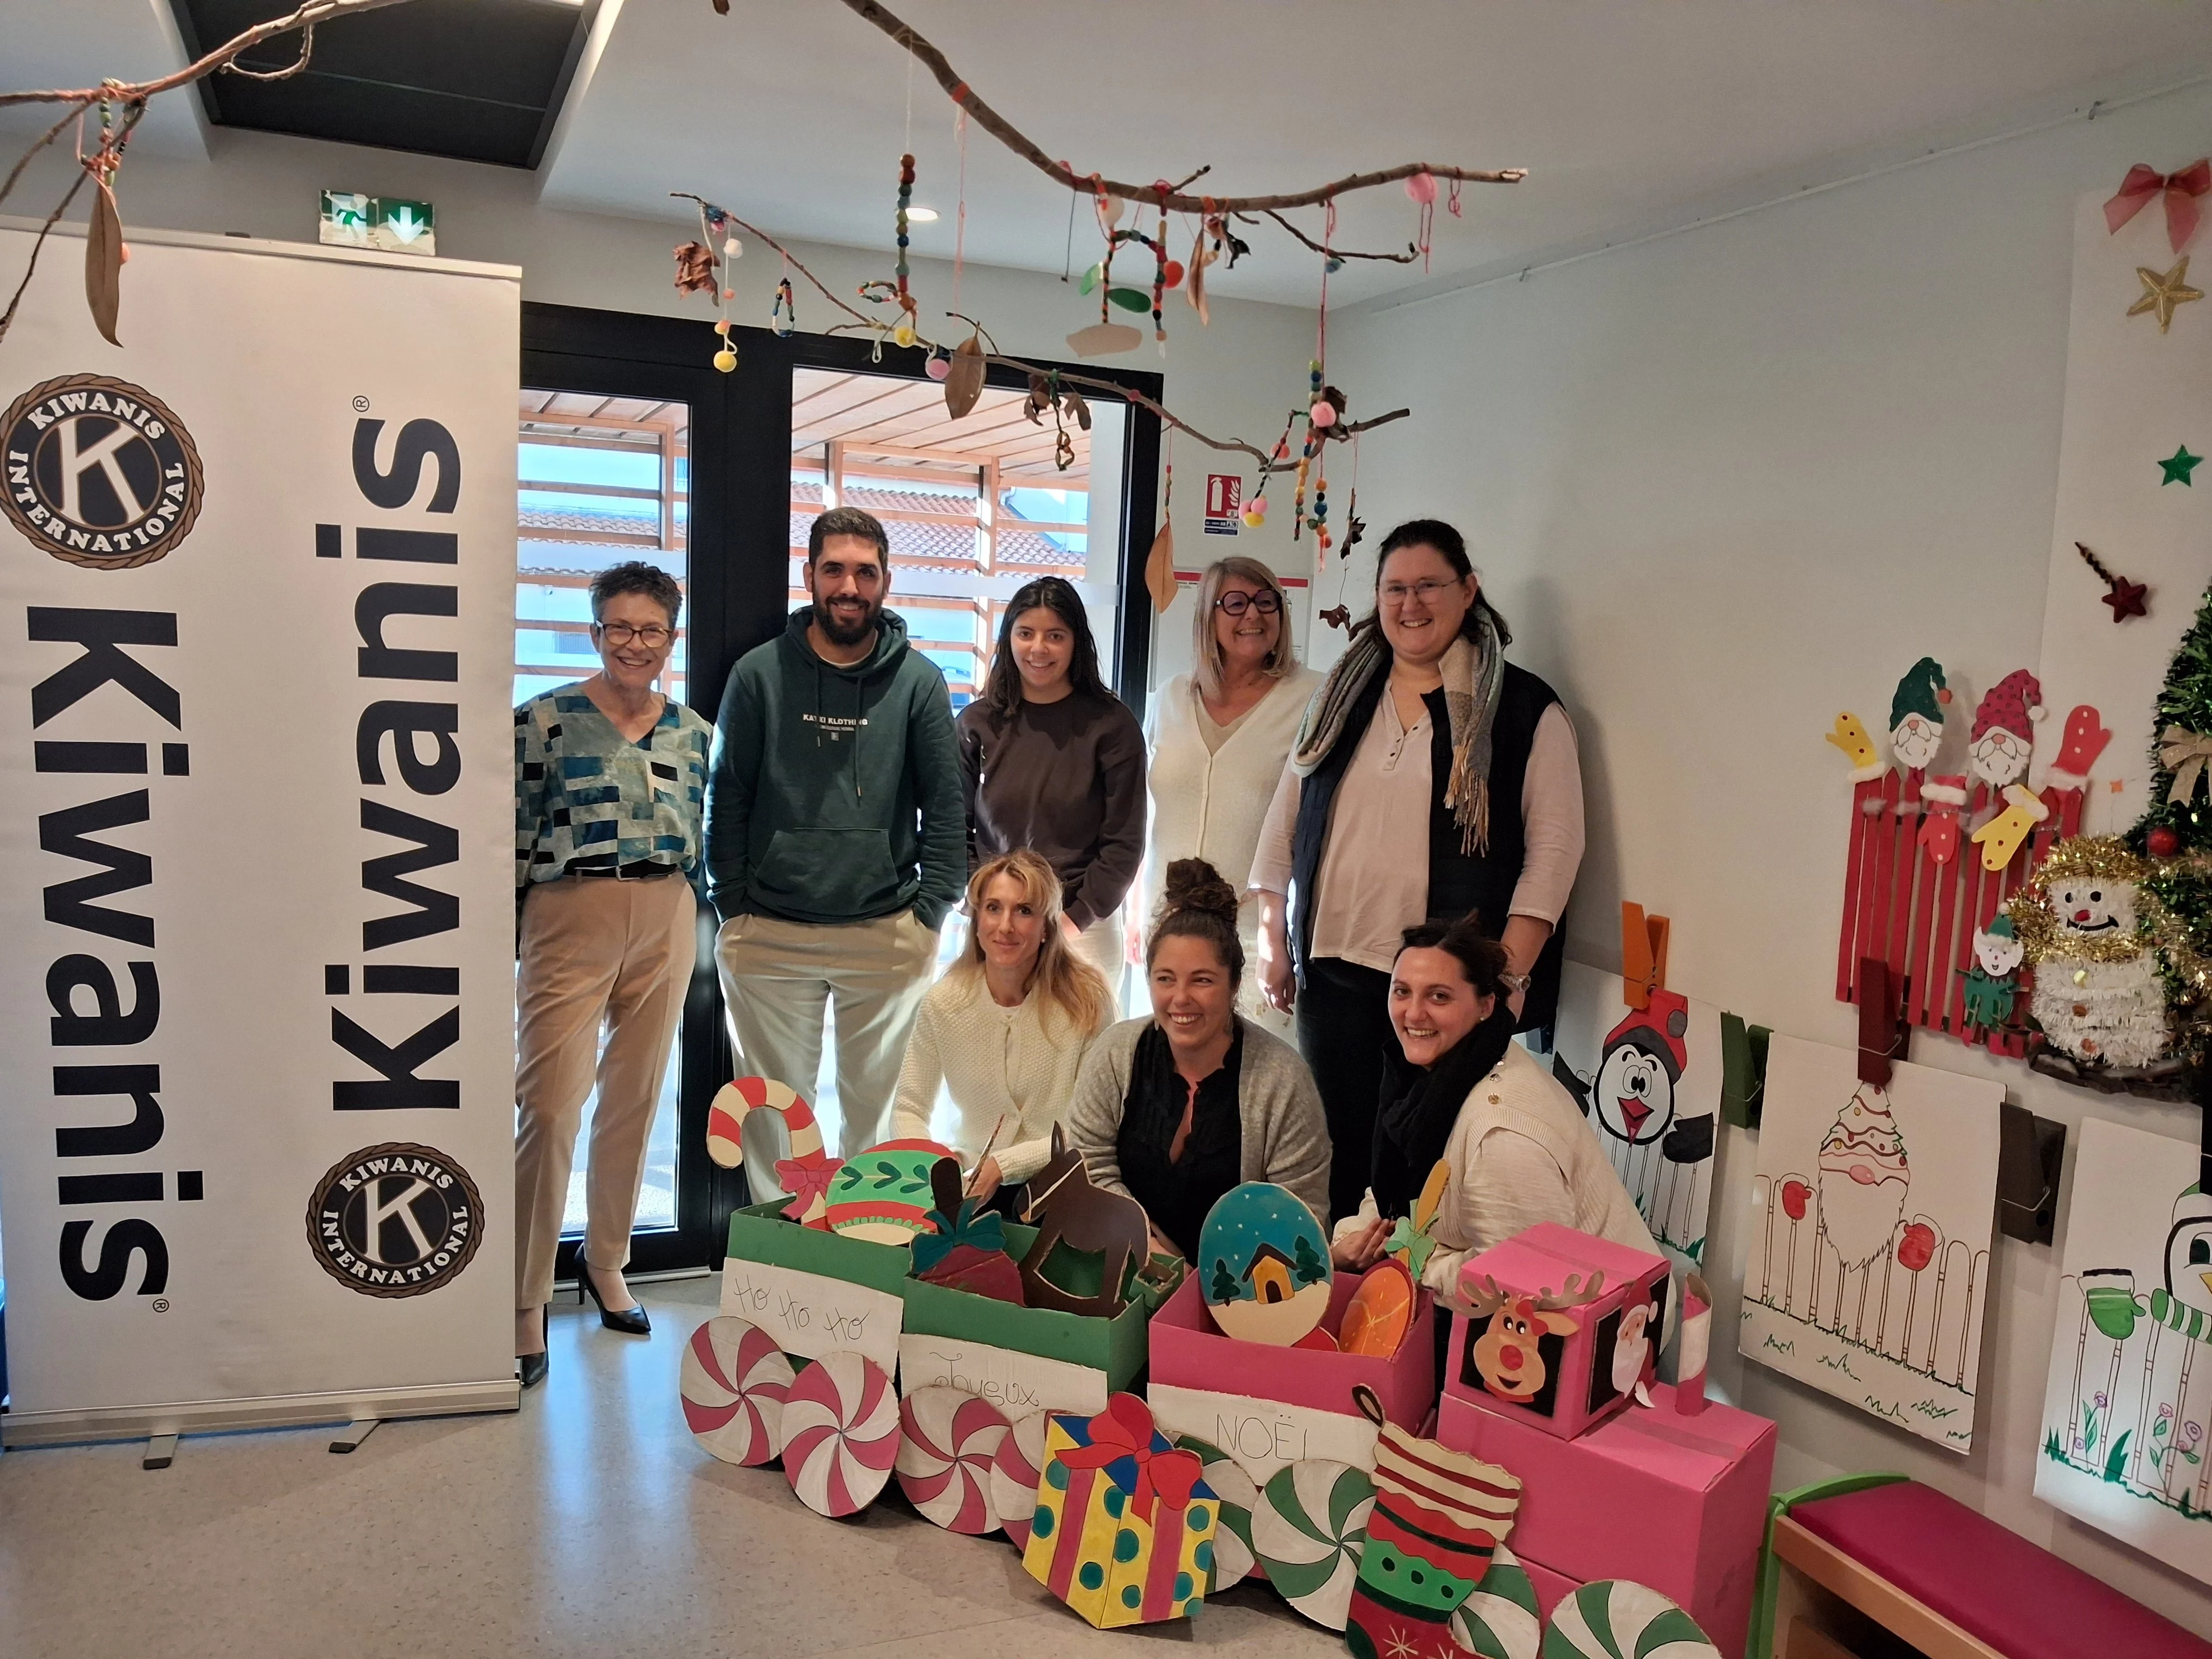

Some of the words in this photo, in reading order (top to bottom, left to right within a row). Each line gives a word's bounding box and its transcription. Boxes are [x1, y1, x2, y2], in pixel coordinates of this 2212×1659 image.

[28, 392, 165, 439] KIWANIS
[9, 450, 185, 552] INTERNATIONAL
[57, 417, 146, 525] K
[339, 1157, 454, 1192] KIWANIS
[323, 1205, 468, 1284] INTERNATIONAL
[364, 1178, 434, 1264] K
